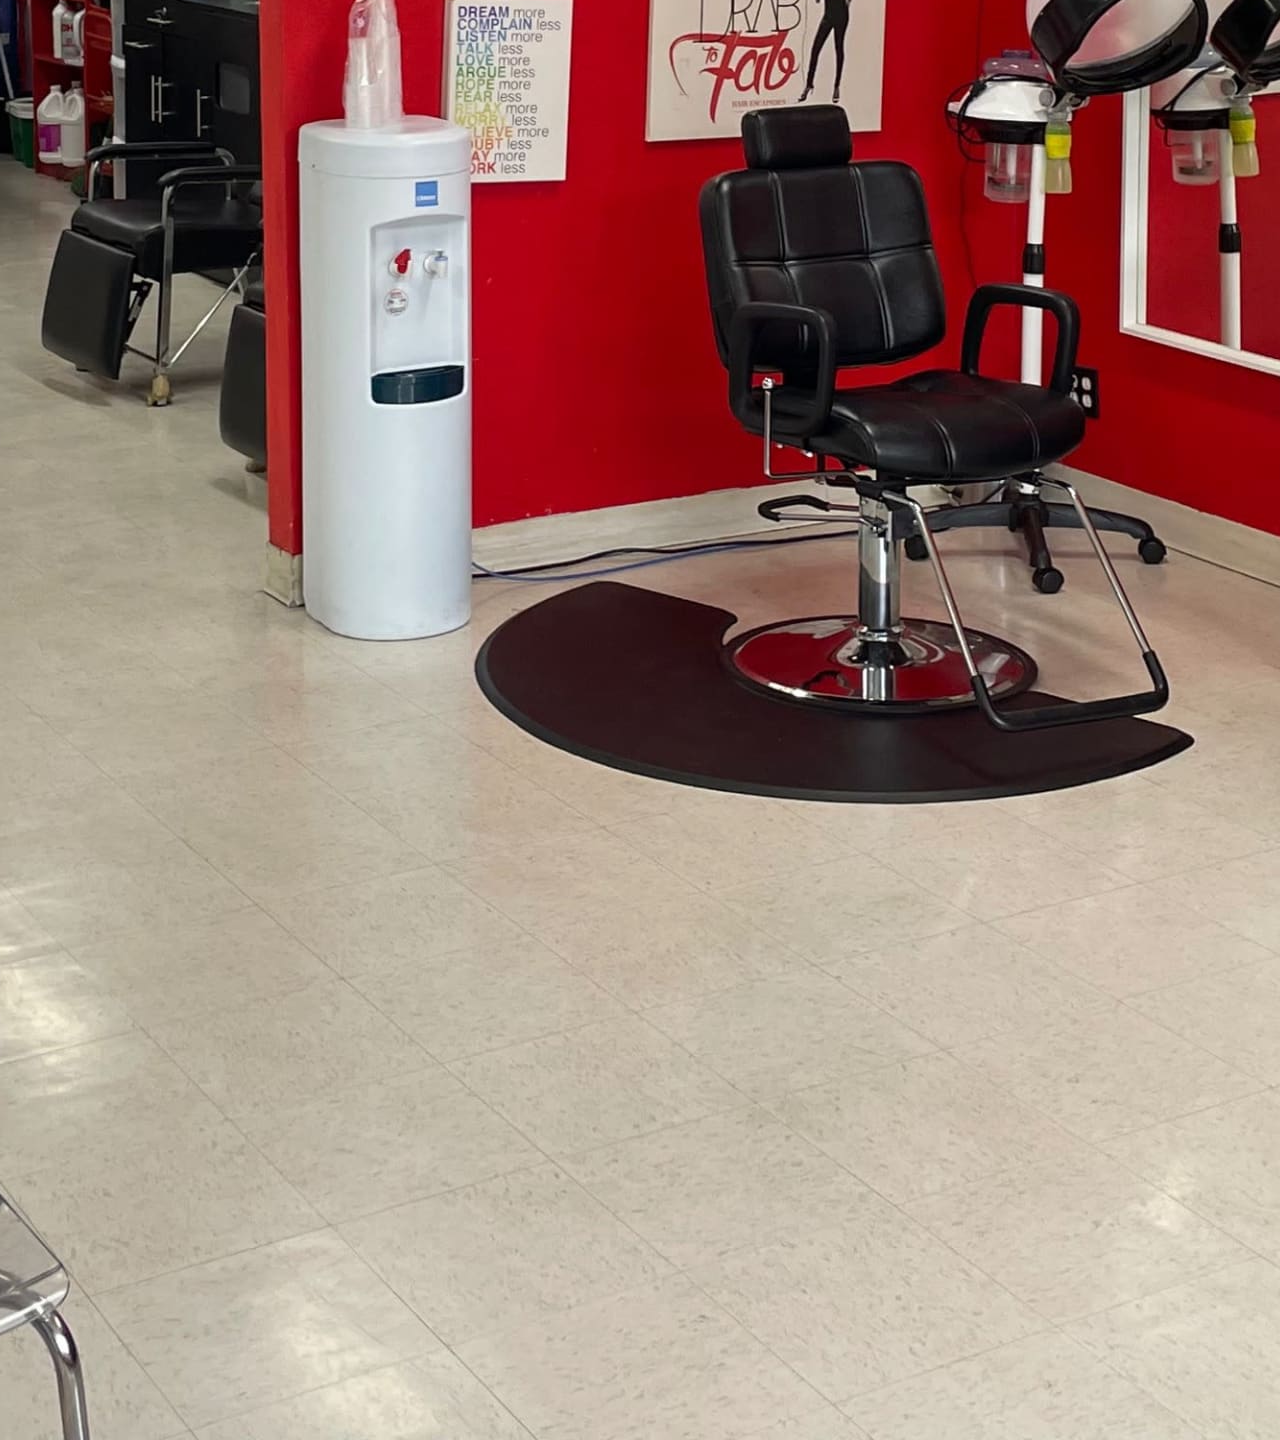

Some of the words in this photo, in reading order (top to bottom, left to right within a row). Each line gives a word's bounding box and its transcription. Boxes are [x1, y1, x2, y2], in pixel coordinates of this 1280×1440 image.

[458, 6, 510, 18] DREAM
[513, 8, 546, 19] more
[457, 18, 532, 30] COMPLAIN
[536, 19, 561, 31] less
[457, 30, 507, 42] LISTEN
[511, 32, 543, 43] more
[456, 42, 493, 54] TALK
[498, 43, 523, 55] less
[456, 54, 494, 66] LOVE
[498, 56, 530, 66] more
[456, 66, 506, 78] ARGUE
[510, 67, 536, 78] less
[455, 78, 495, 90] HOPE
[499, 80, 531, 90] more
[669, 34, 799, 123] Fab
[455, 91, 492, 102] FEAR
[497, 91, 522, 102] less
[455, 103, 501, 115] RELAX
[506, 104, 538, 114] more
[511, 114, 537, 126] less
[517, 127, 549, 138] more
[507, 138, 532, 150] less
[472, 150, 490, 162] AY
[494, 152, 526, 162] more
[501, 162, 526, 174] less
